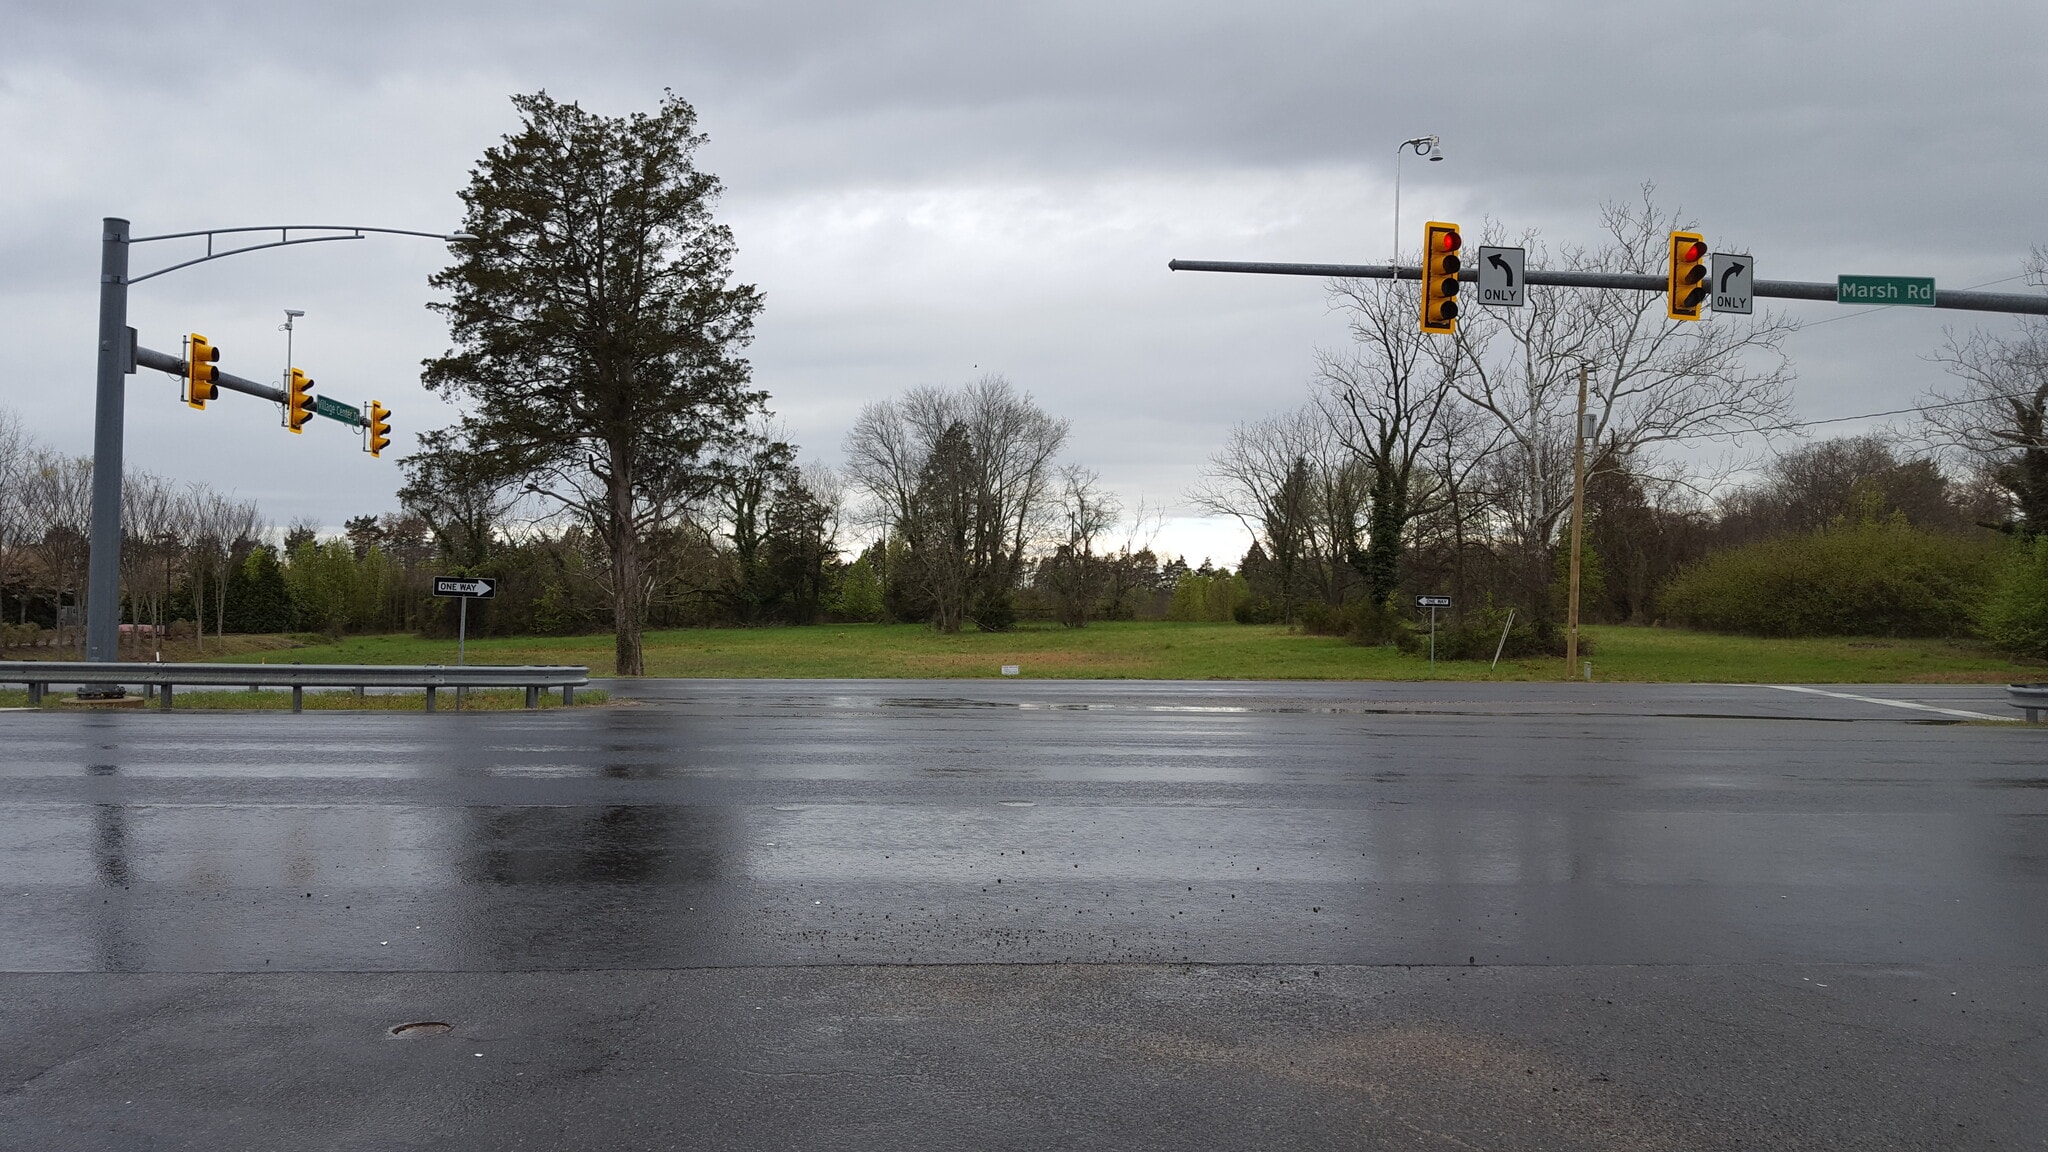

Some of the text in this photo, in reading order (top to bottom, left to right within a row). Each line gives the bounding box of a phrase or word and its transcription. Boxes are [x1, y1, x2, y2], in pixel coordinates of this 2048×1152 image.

[1484, 288, 1517, 301] ONLY
[1842, 282, 1931, 299] Marsh Rd
[1717, 296, 1747, 309] ONLY
[318, 399, 336, 415] Village
[336, 406, 353, 419] Center
[440, 582, 477, 591] ONE WAY
